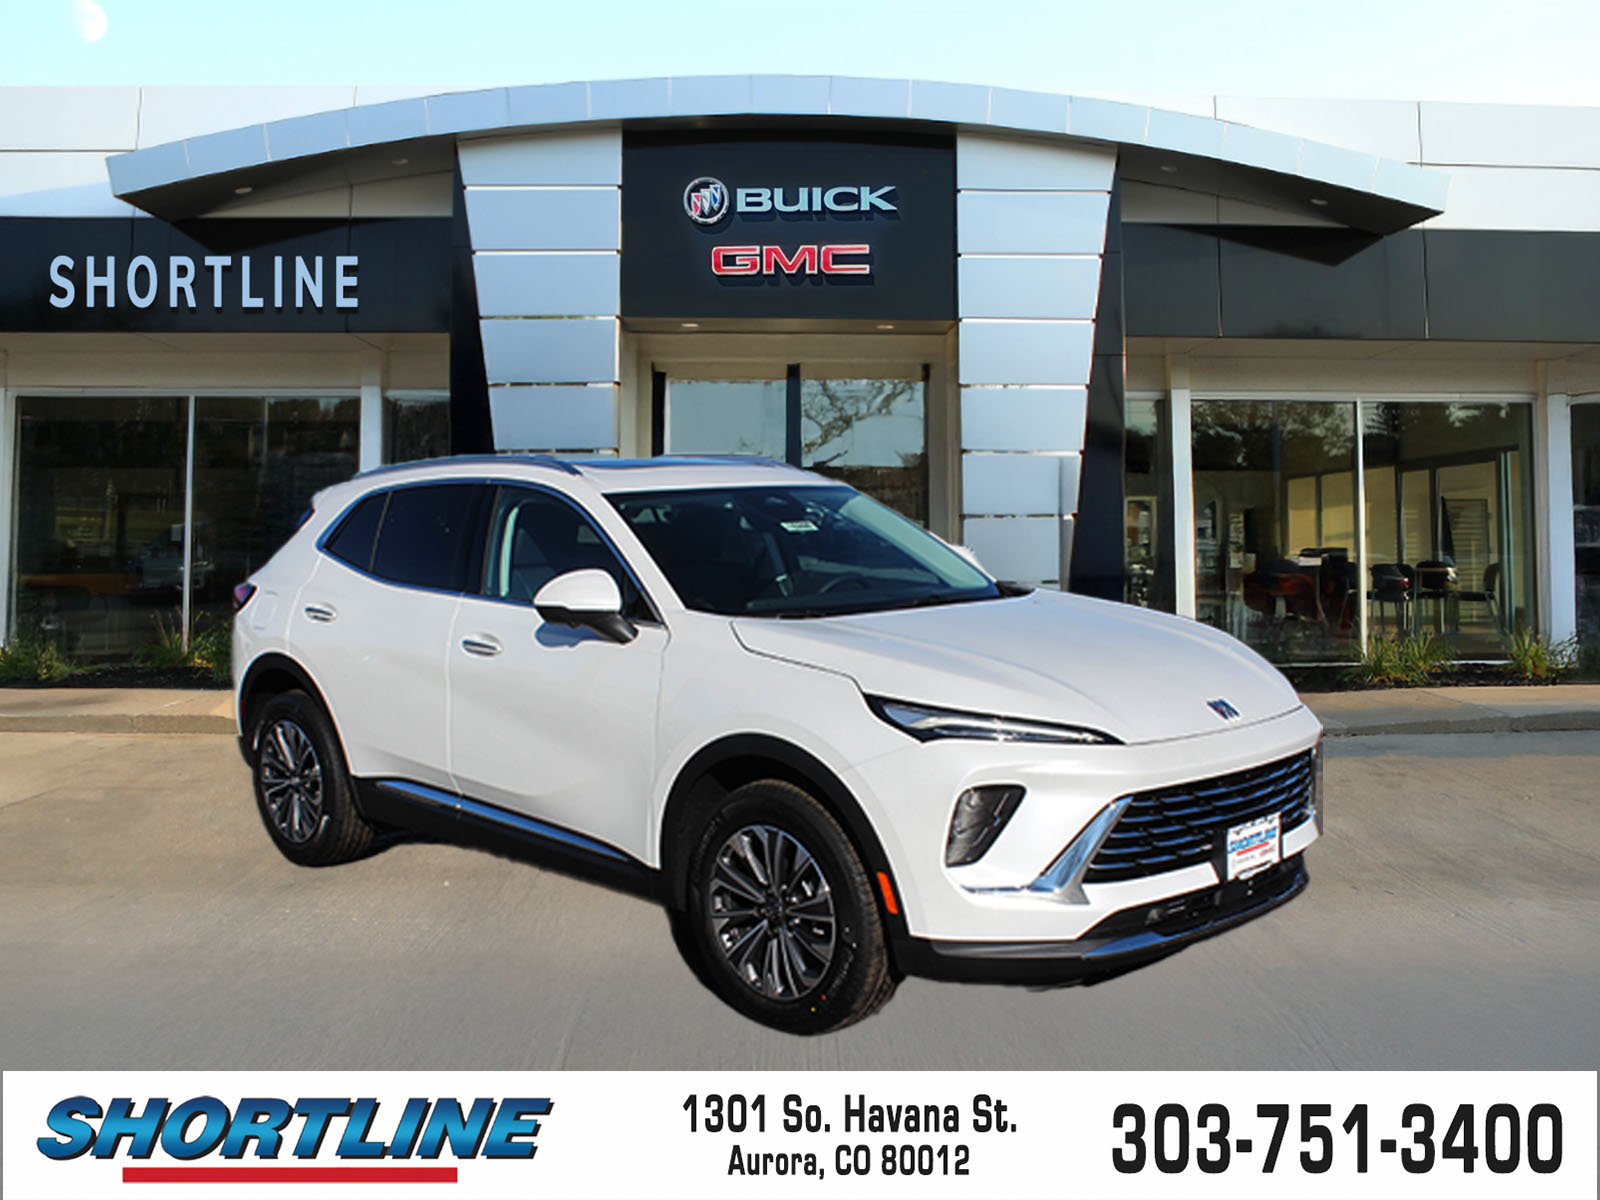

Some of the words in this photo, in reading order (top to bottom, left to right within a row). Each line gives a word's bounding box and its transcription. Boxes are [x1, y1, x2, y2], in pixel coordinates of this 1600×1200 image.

[737, 186, 898, 212] BUICK
[711, 244, 870, 275] GMC
[49, 255, 359, 308] SHORTLINE
